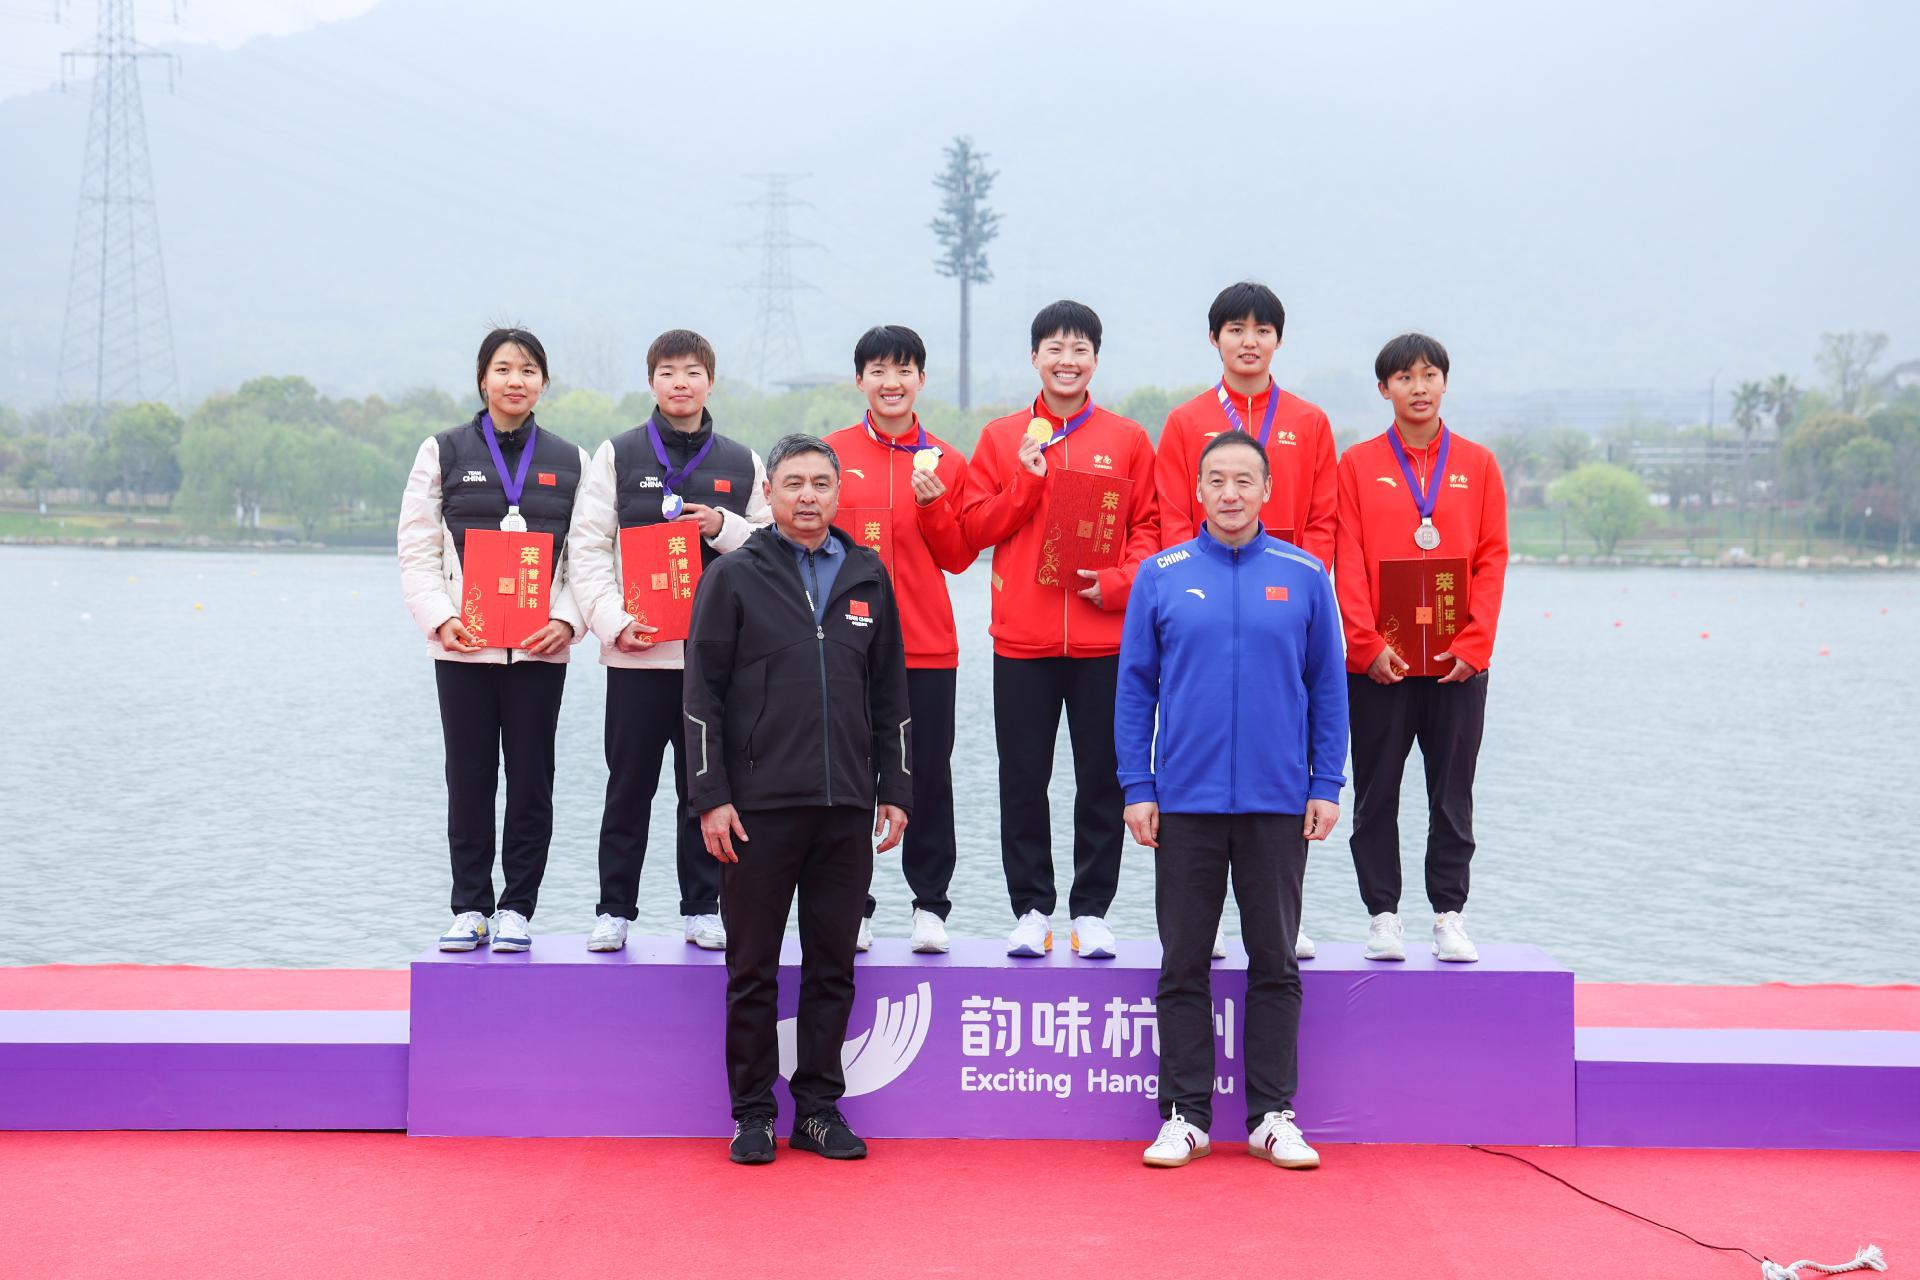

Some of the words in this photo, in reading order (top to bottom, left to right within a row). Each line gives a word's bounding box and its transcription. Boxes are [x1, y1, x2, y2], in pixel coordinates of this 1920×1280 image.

[639, 480, 664, 488] CHINA
[1156, 549, 1191, 569] CHINA
[961, 1066, 1072, 1099] Exciting
[1087, 1067, 1234, 1100] Hangu
